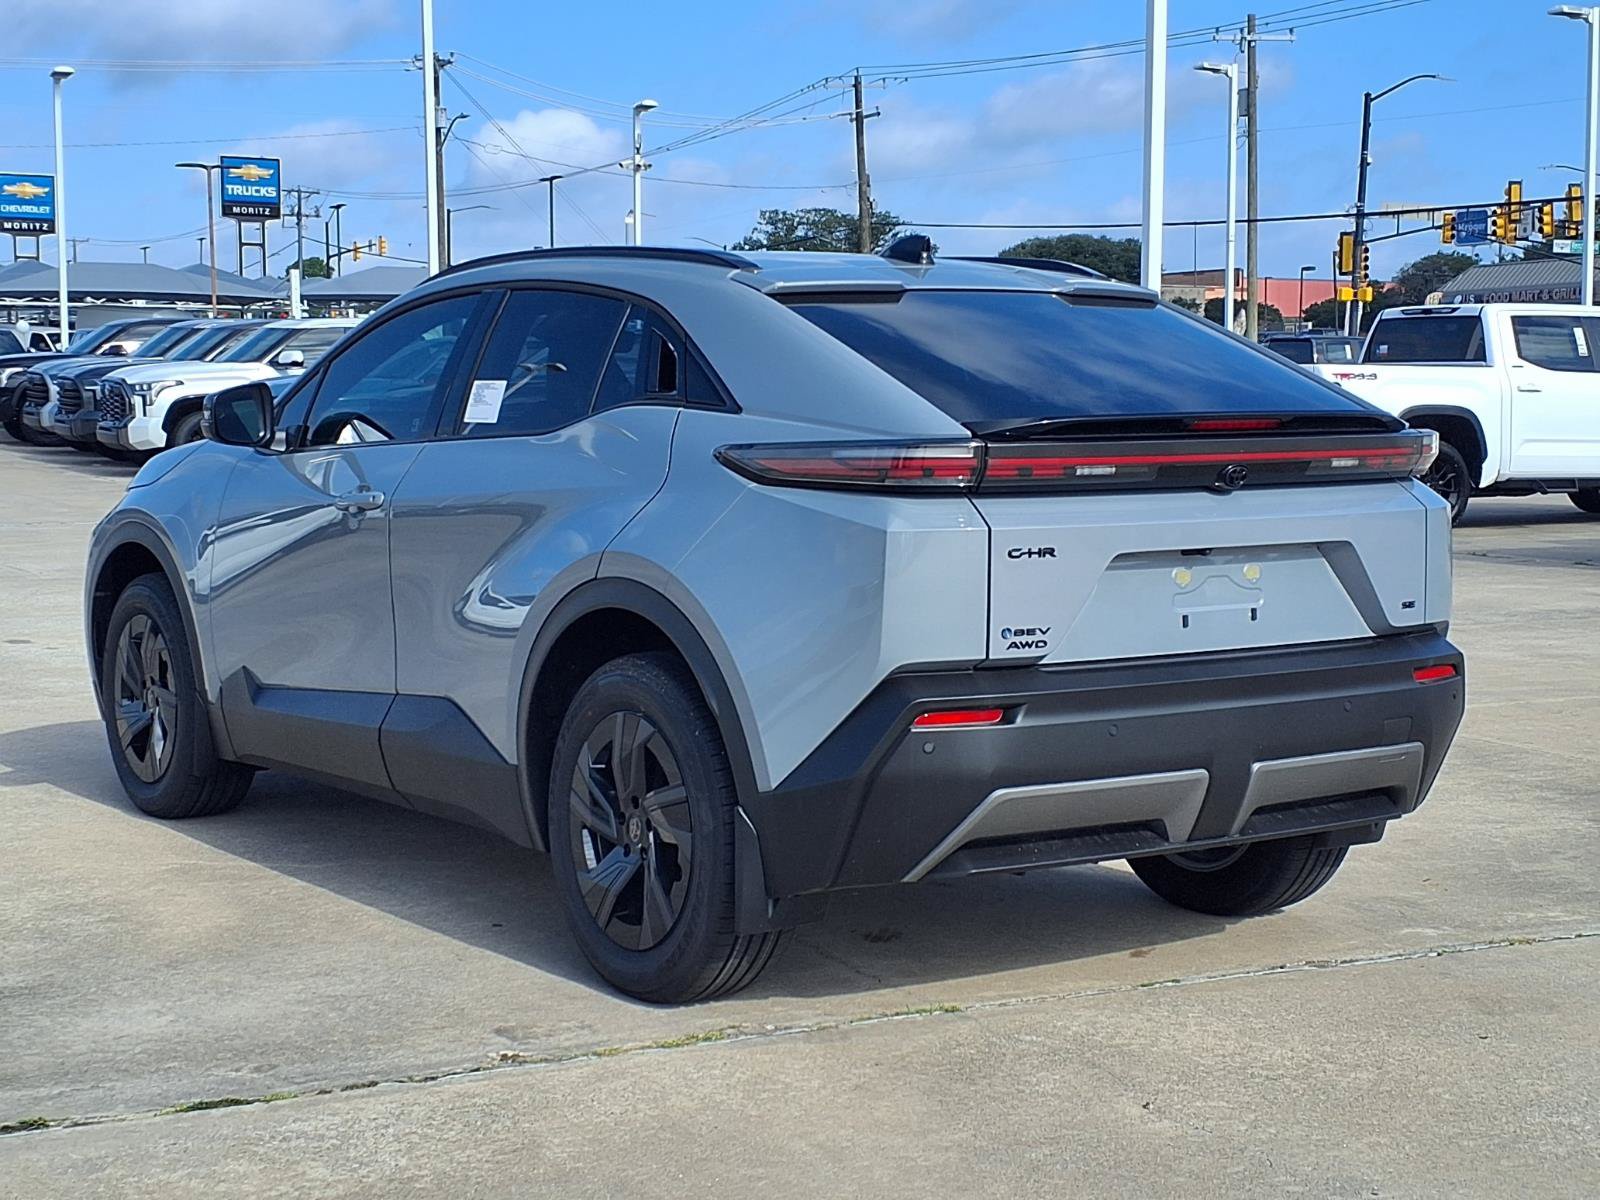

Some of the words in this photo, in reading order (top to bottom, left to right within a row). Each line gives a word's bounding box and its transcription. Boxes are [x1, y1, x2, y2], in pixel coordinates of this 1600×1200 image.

[226, 185, 277, 197] TRUCKS
[0, 204, 51, 214] CHEVROLET
[232, 206, 271, 215] MORITZ
[3, 222, 49, 231] MORITZ
[1483, 293, 1509, 303] FOOD
[1511, 290, 1540, 302] MART
[1542, 288, 1550, 300] &
[1552, 287, 1581, 300] GRILL
[1401, 600, 1416, 610] SE
[1013, 627, 1051, 637] BEV
[1006, 640, 1048, 650] AWD
